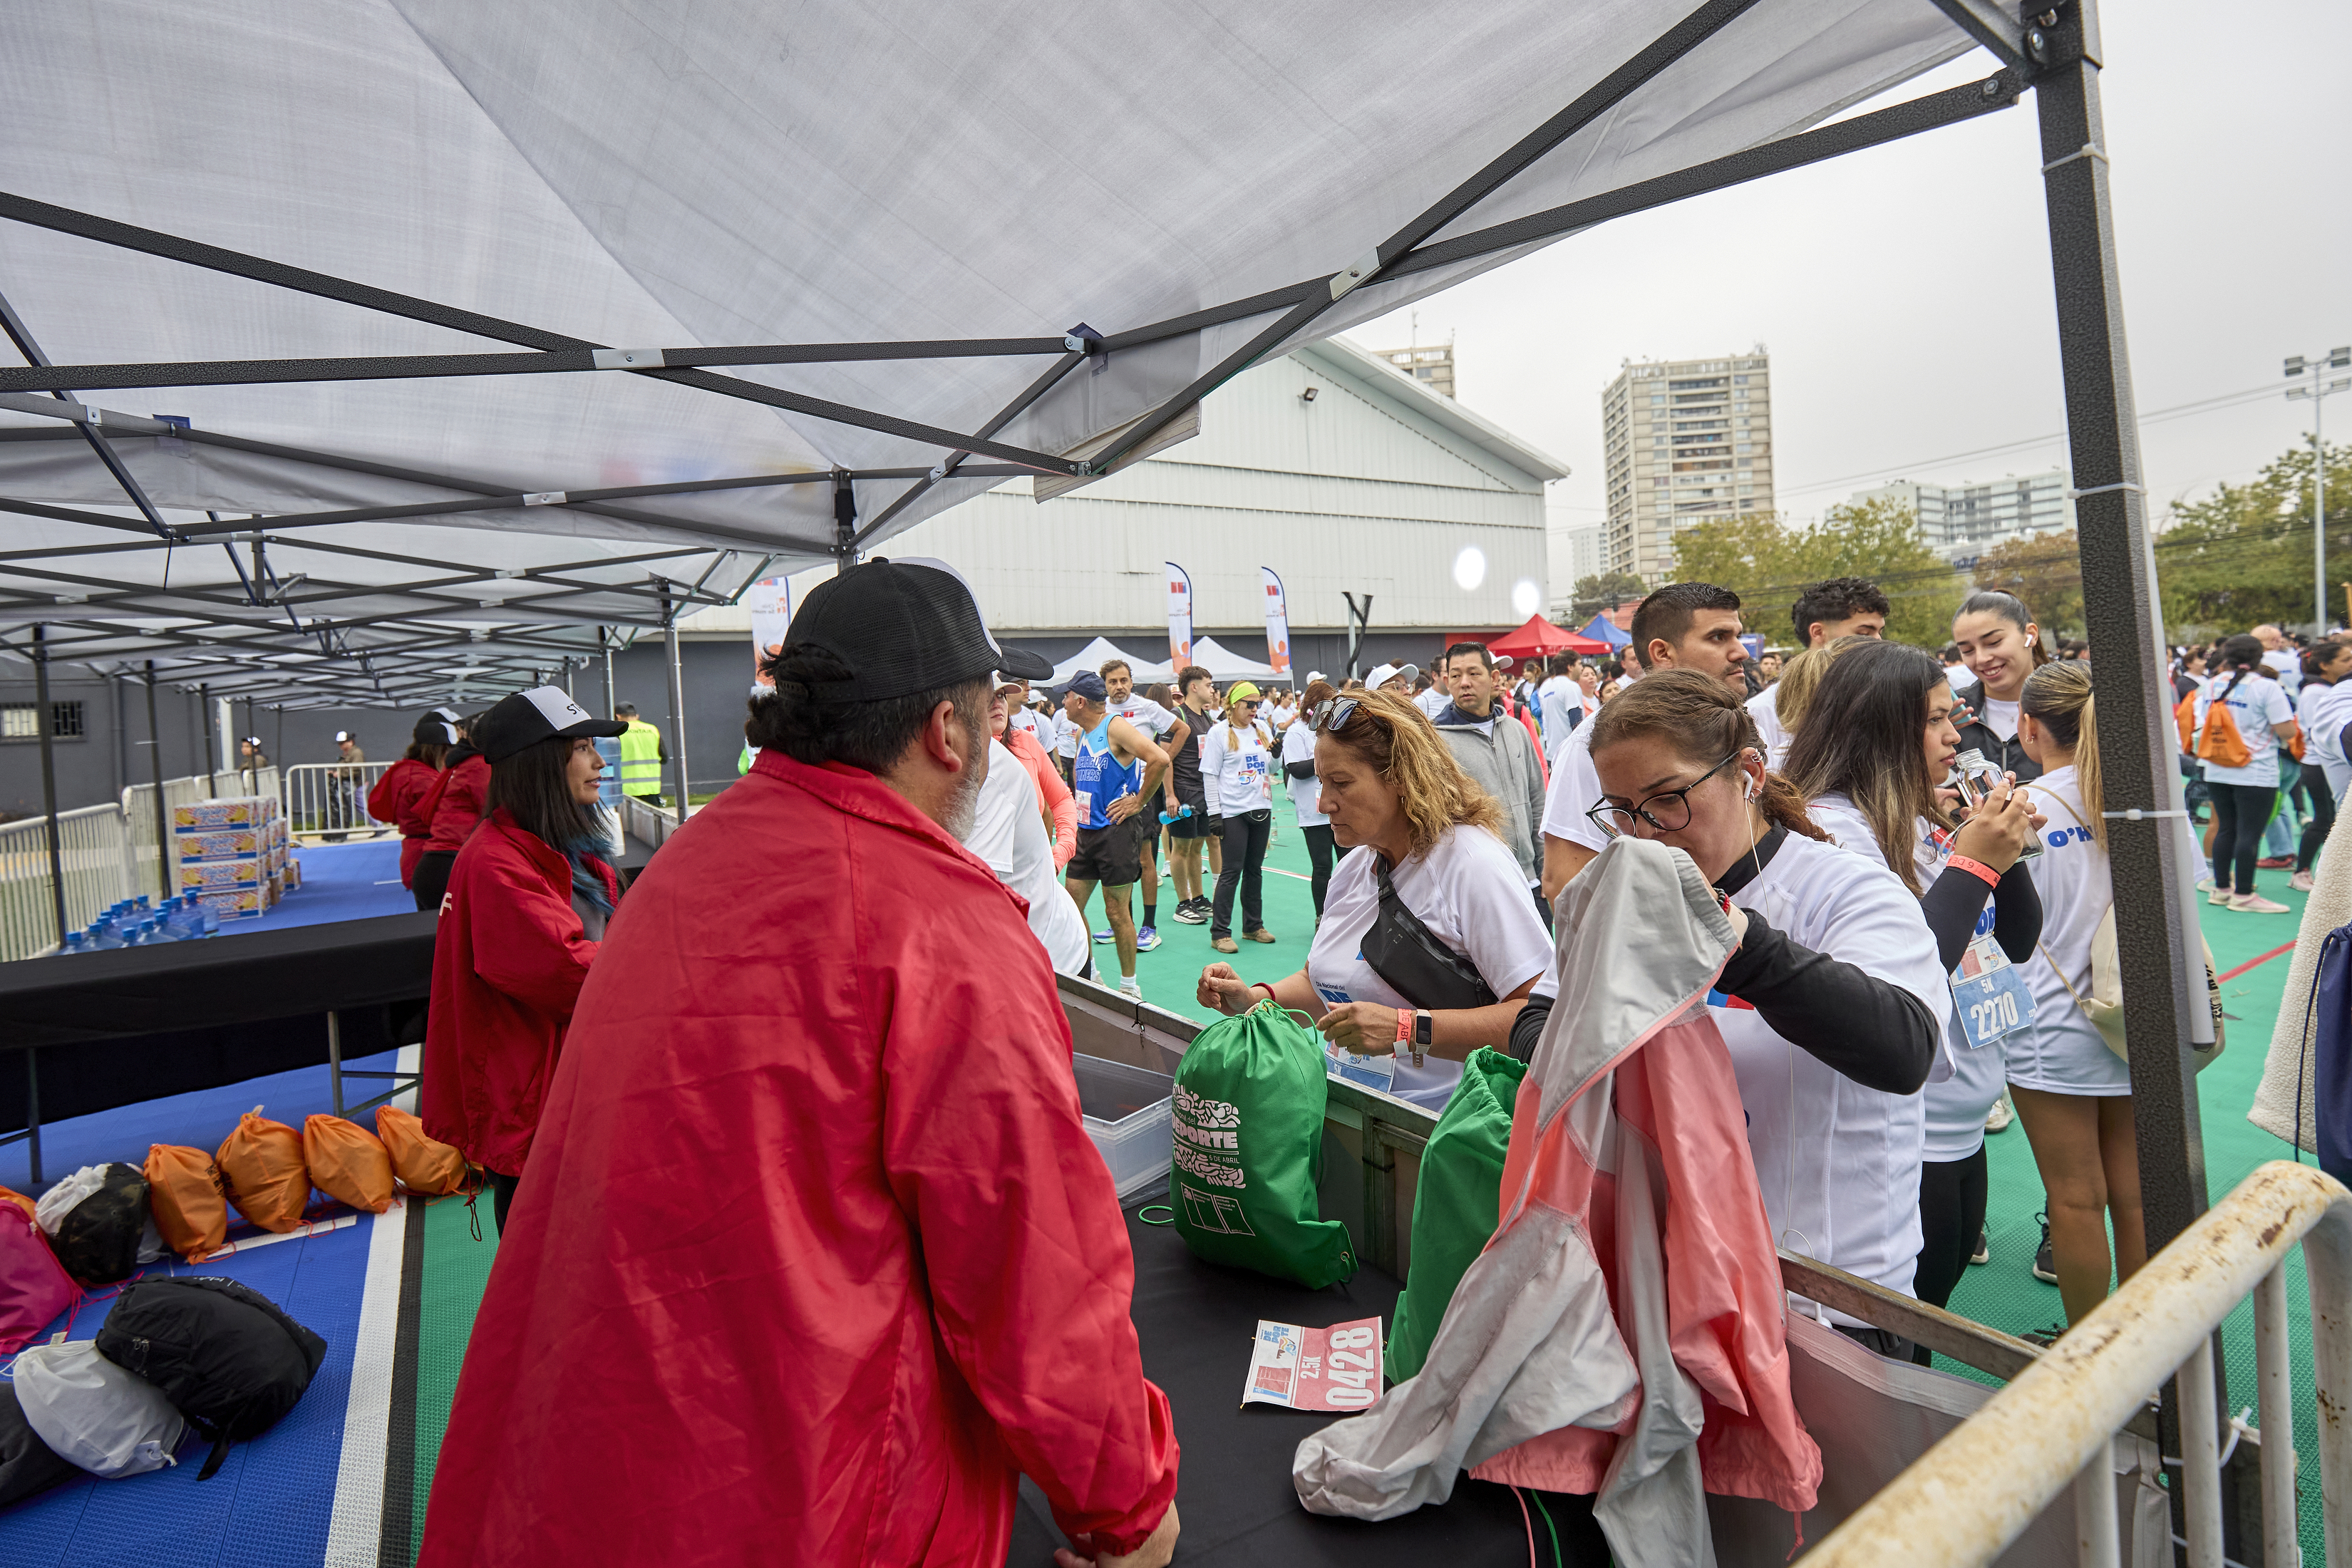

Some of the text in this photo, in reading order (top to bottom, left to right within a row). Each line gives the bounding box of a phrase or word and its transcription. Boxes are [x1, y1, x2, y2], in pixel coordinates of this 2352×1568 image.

[567, 703, 581, 715] ST
[1981, 977, 1995, 994] 5K
[1402, 1012, 1410, 1022] DE
[1970, 991, 2018, 1041] 2270
[1187, 1116, 1196, 1125] del
[1172, 1112, 1238, 1148] DEPORTE
[1263, 1329, 1272, 1342] DE
[1272, 1326, 1281, 1343] POR
[1281, 1327, 1289, 1337] TE
[1301, 1356, 1321, 1379] 2,5K
[1326, 1326, 1374, 1406] 0428
